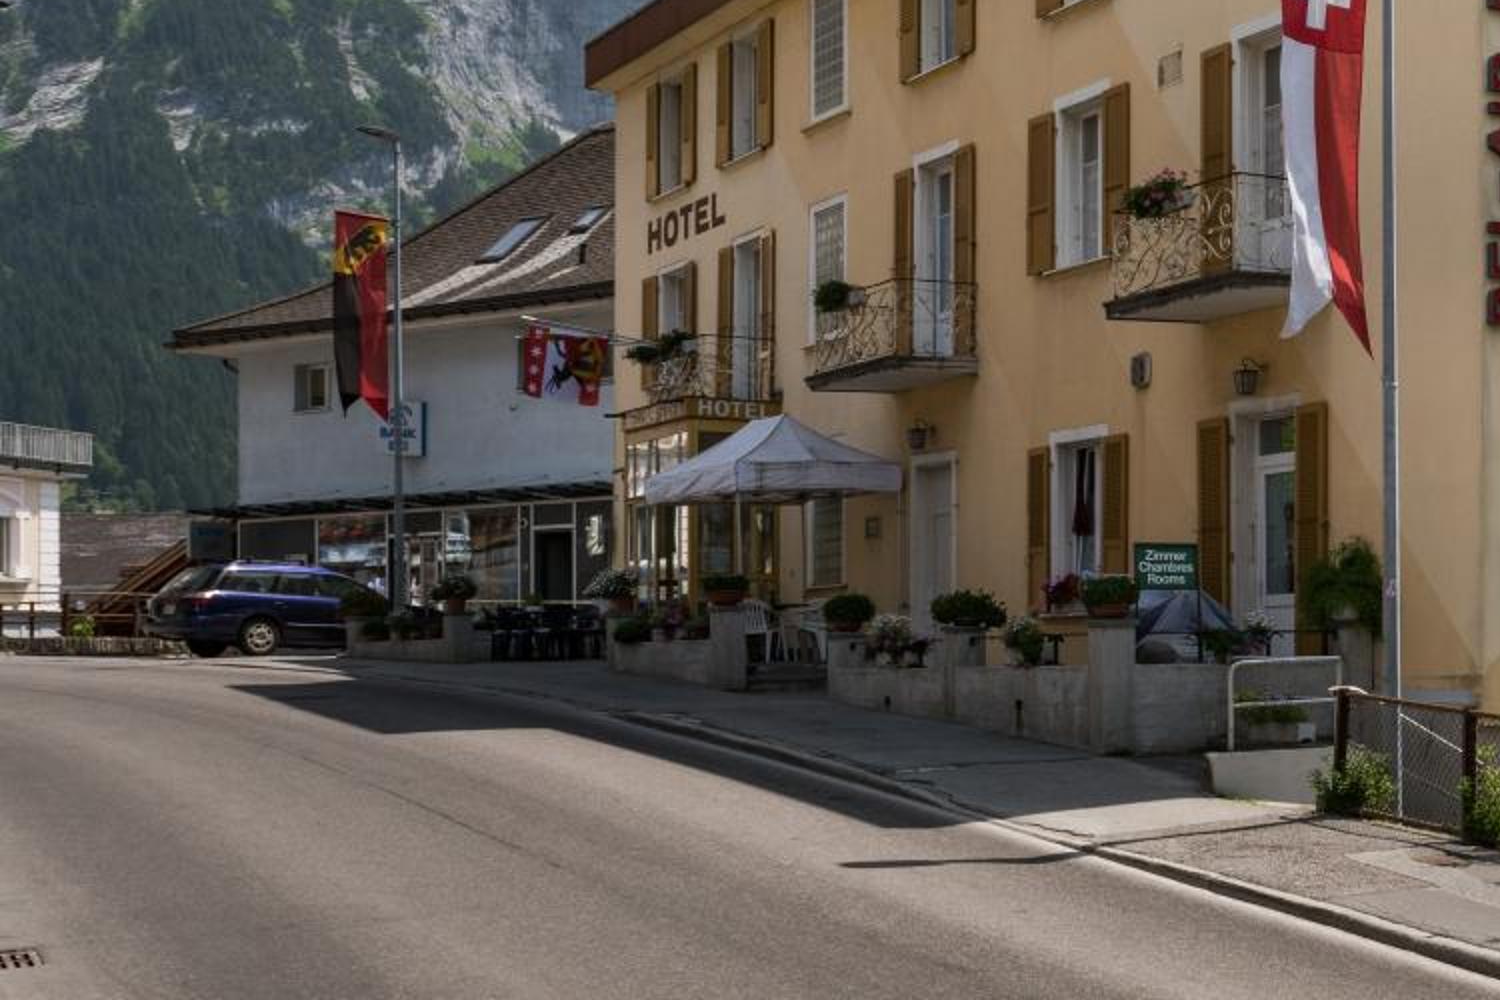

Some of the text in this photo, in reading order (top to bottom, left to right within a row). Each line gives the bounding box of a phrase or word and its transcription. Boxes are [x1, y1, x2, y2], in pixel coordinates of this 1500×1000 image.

[647, 192, 726, 256] HOTEL
[698, 400, 767, 419] HOTEL
[1144, 549, 1187, 561] Zimmer
[1138, 561, 1195, 573] Chambres
[1146, 573, 1186, 585] Rooms
